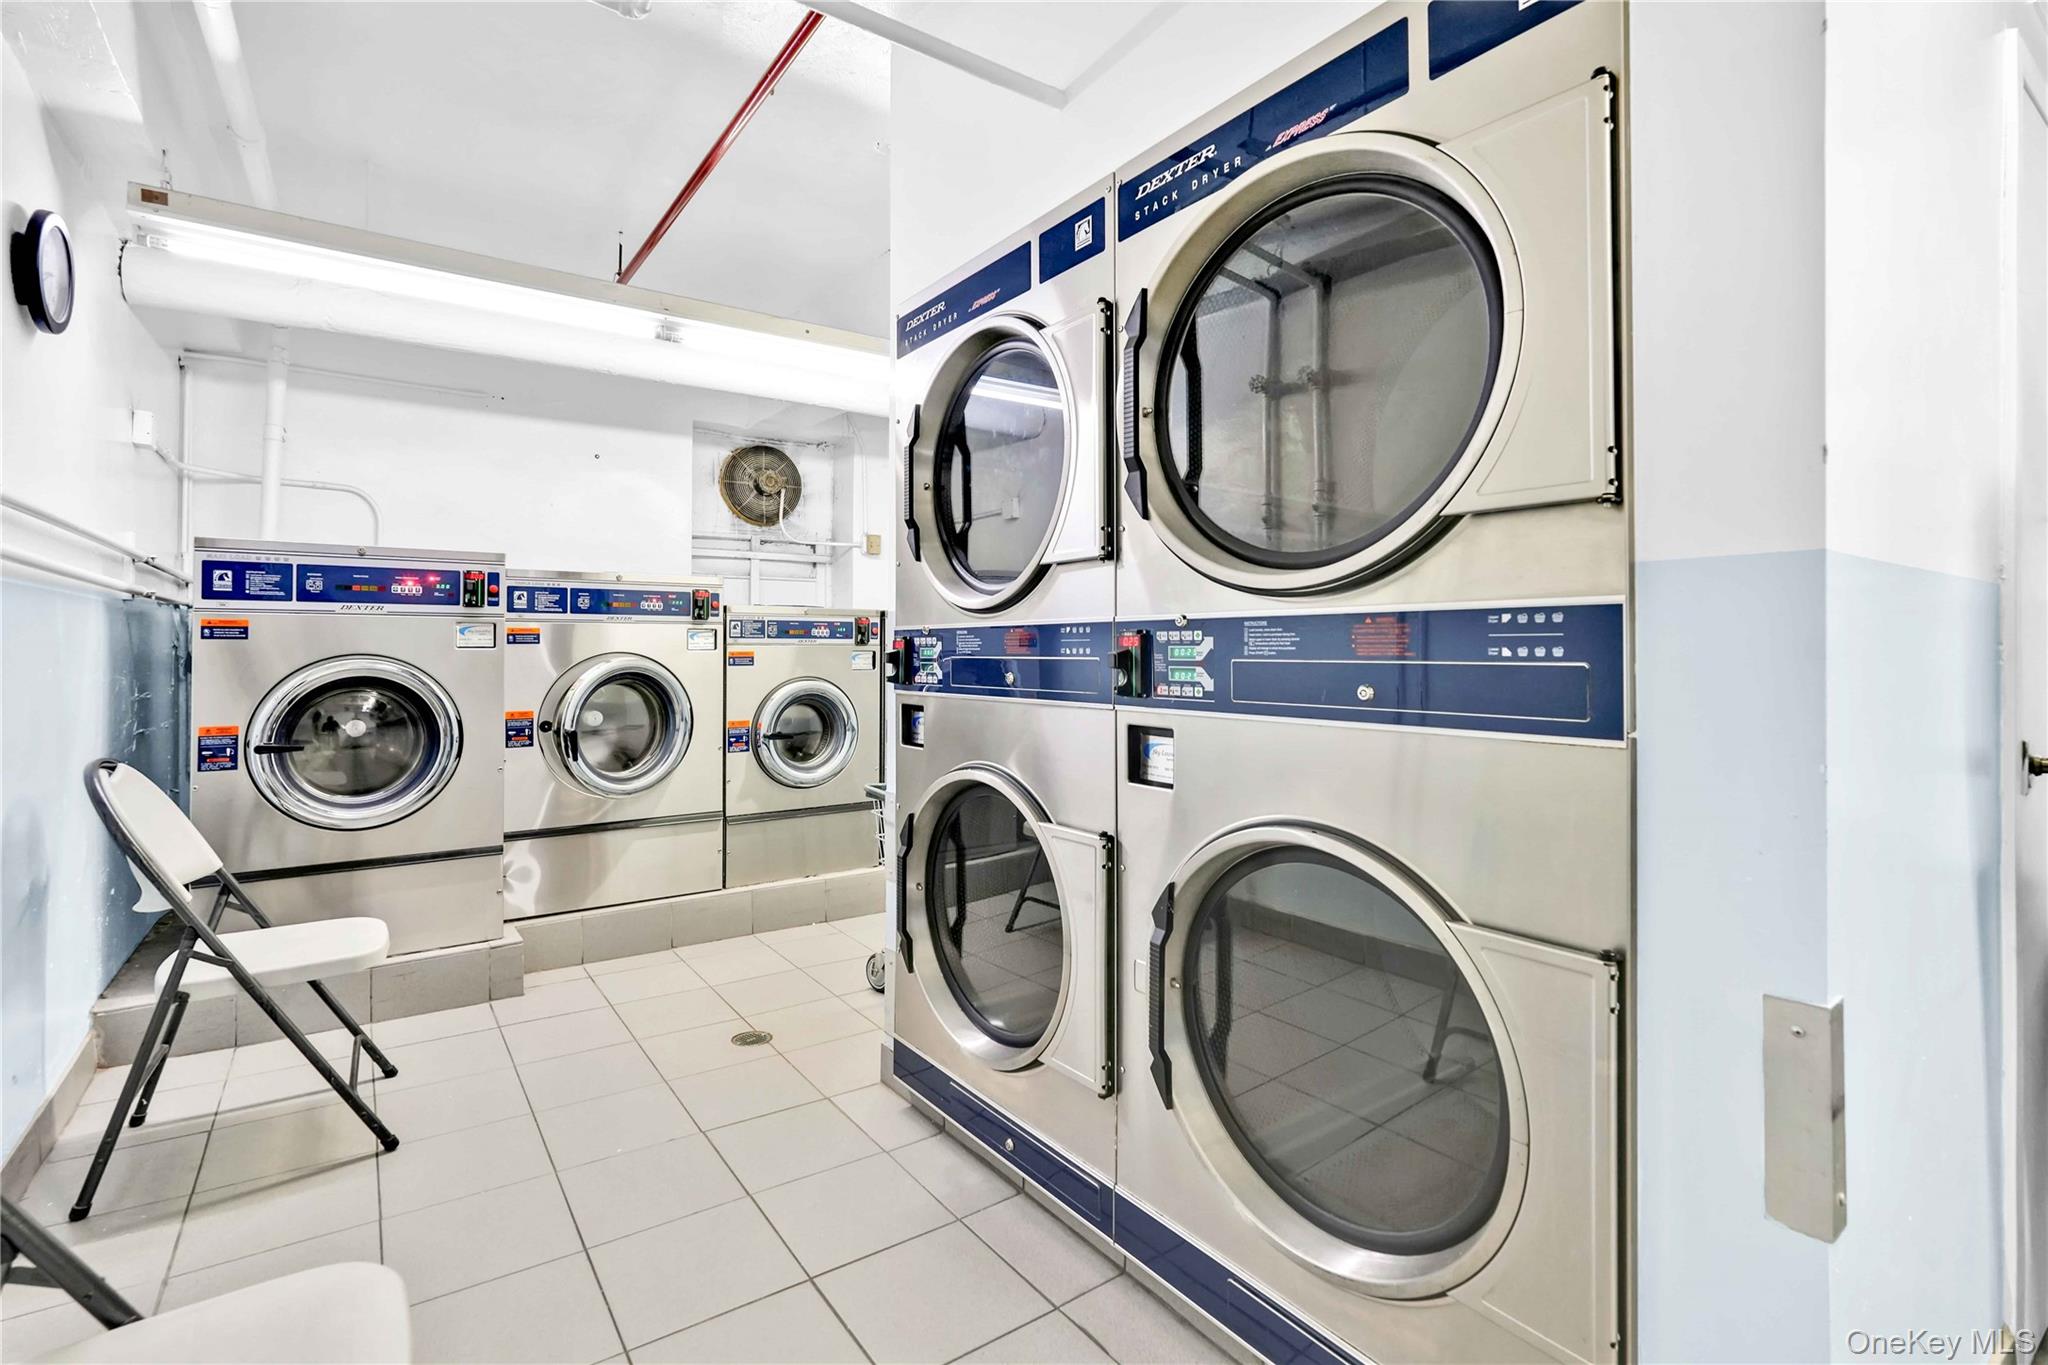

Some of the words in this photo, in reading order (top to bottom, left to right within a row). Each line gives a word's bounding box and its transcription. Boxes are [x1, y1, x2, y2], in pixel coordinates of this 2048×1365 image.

[1272, 107, 1329, 148] EXPRESS
[1134, 190, 1178, 220] STACK
[1191, 156, 1241, 190] DRYER
[1135, 144, 1217, 200] DEXTER
[905, 301, 947, 331] DEXTER
[905, 329, 927, 346] STACK
[933, 312, 958, 331] DRYER
